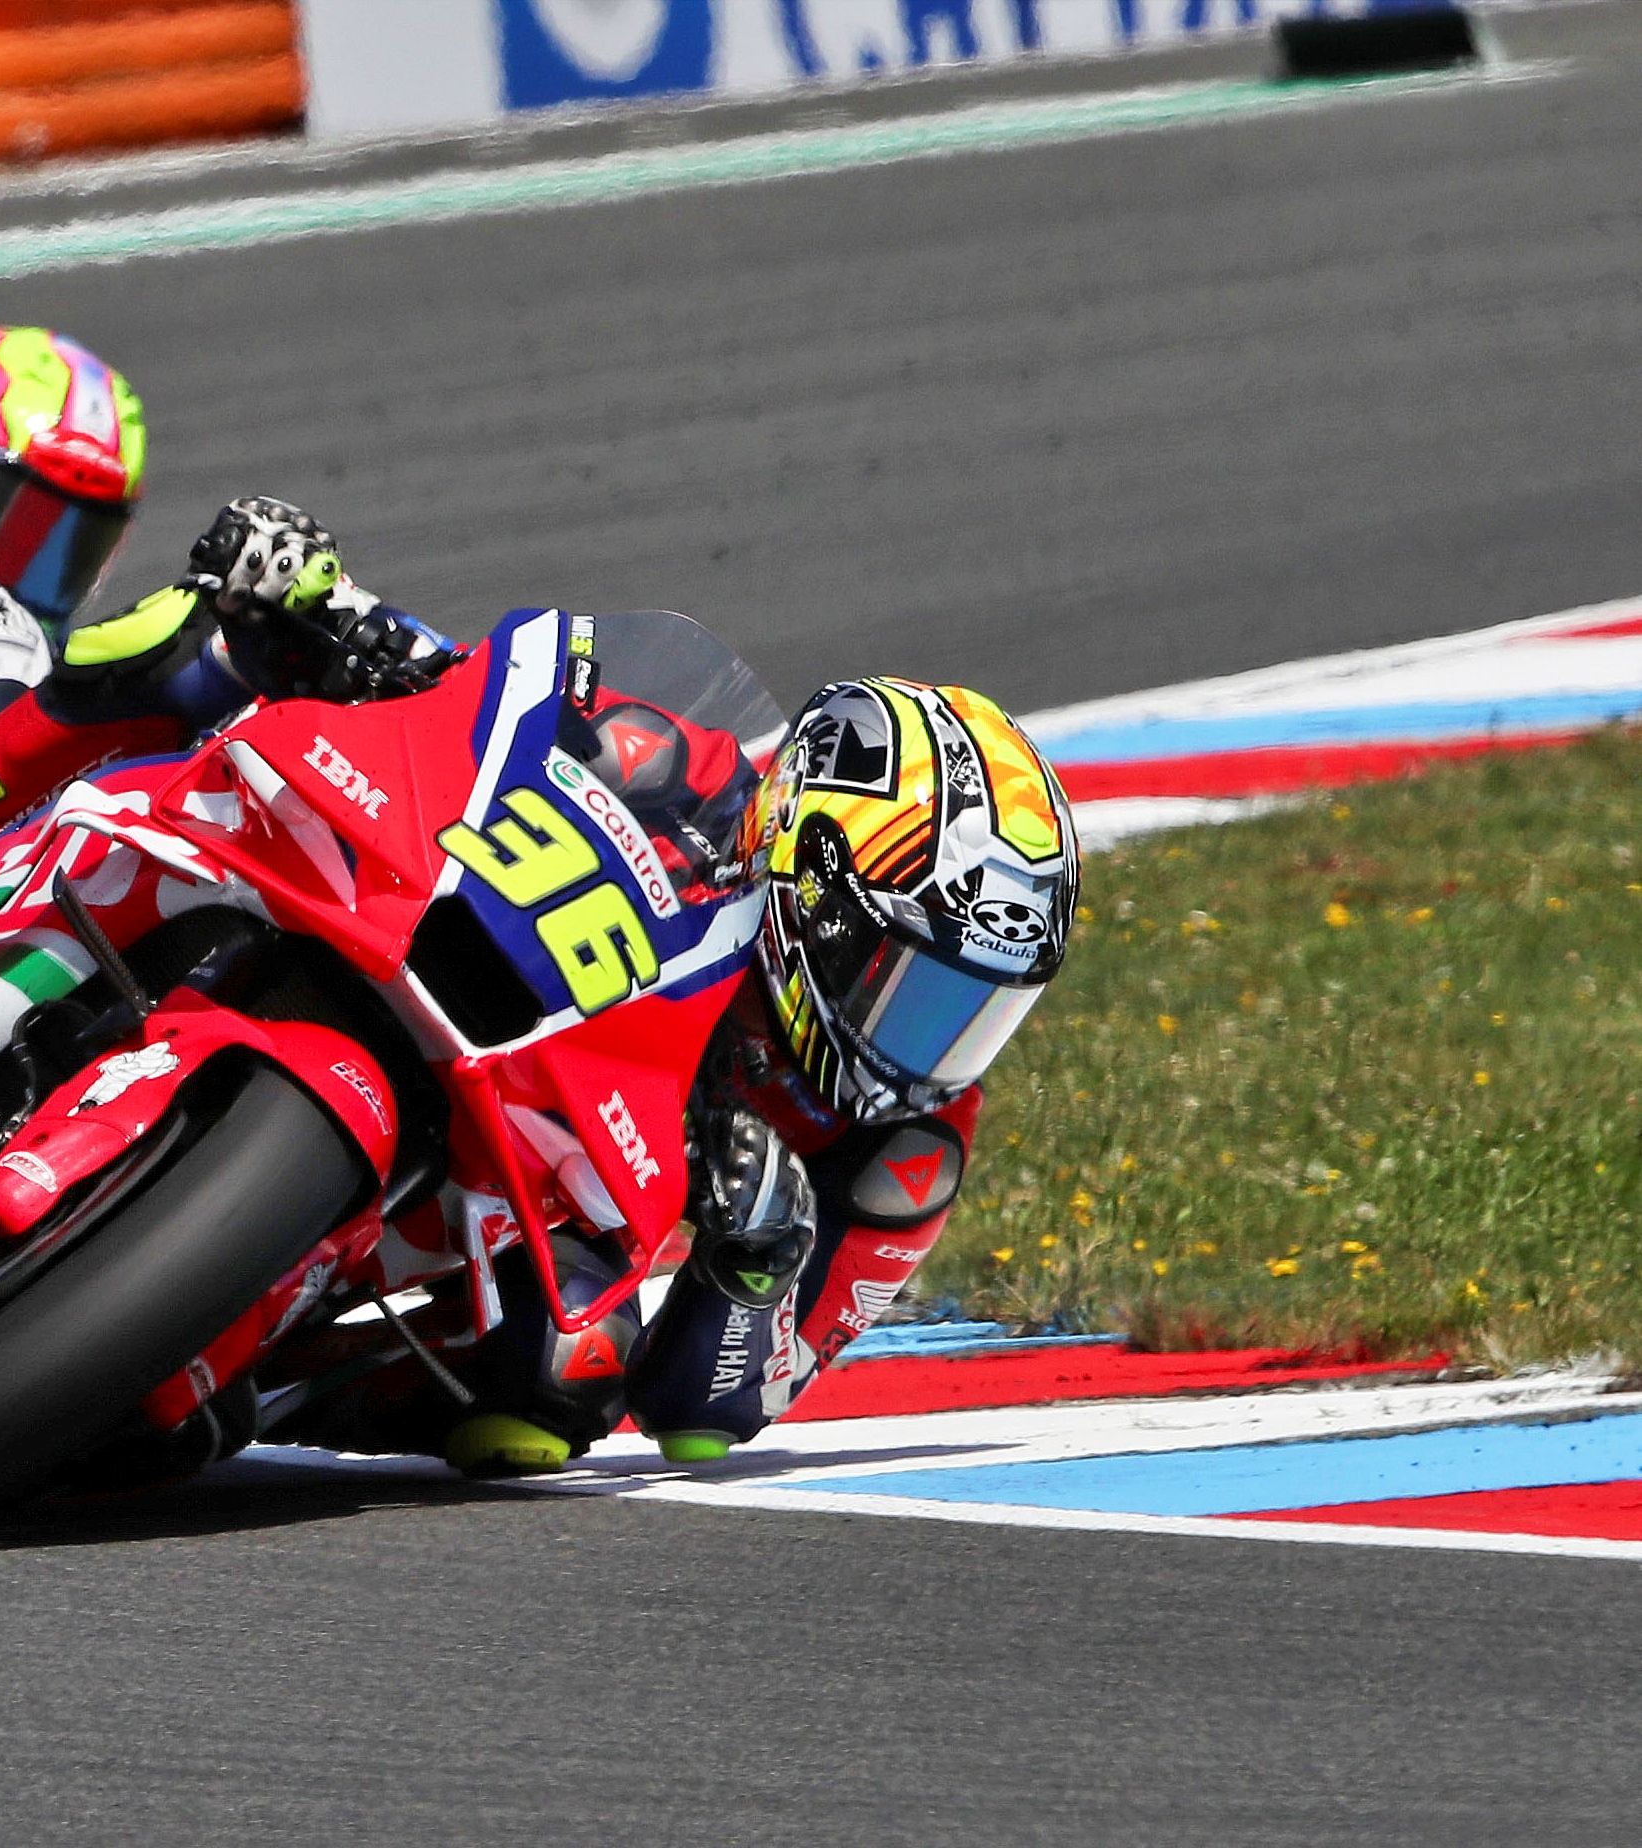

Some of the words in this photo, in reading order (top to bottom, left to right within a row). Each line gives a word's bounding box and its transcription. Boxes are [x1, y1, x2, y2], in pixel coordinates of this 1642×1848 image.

[302, 734, 390, 820] IBM
[584, 787, 672, 912] Castrol
[436, 786, 661, 1018] 36
[963, 929, 1038, 959] Kabuto
[597, 1089, 661, 1191] IBM
